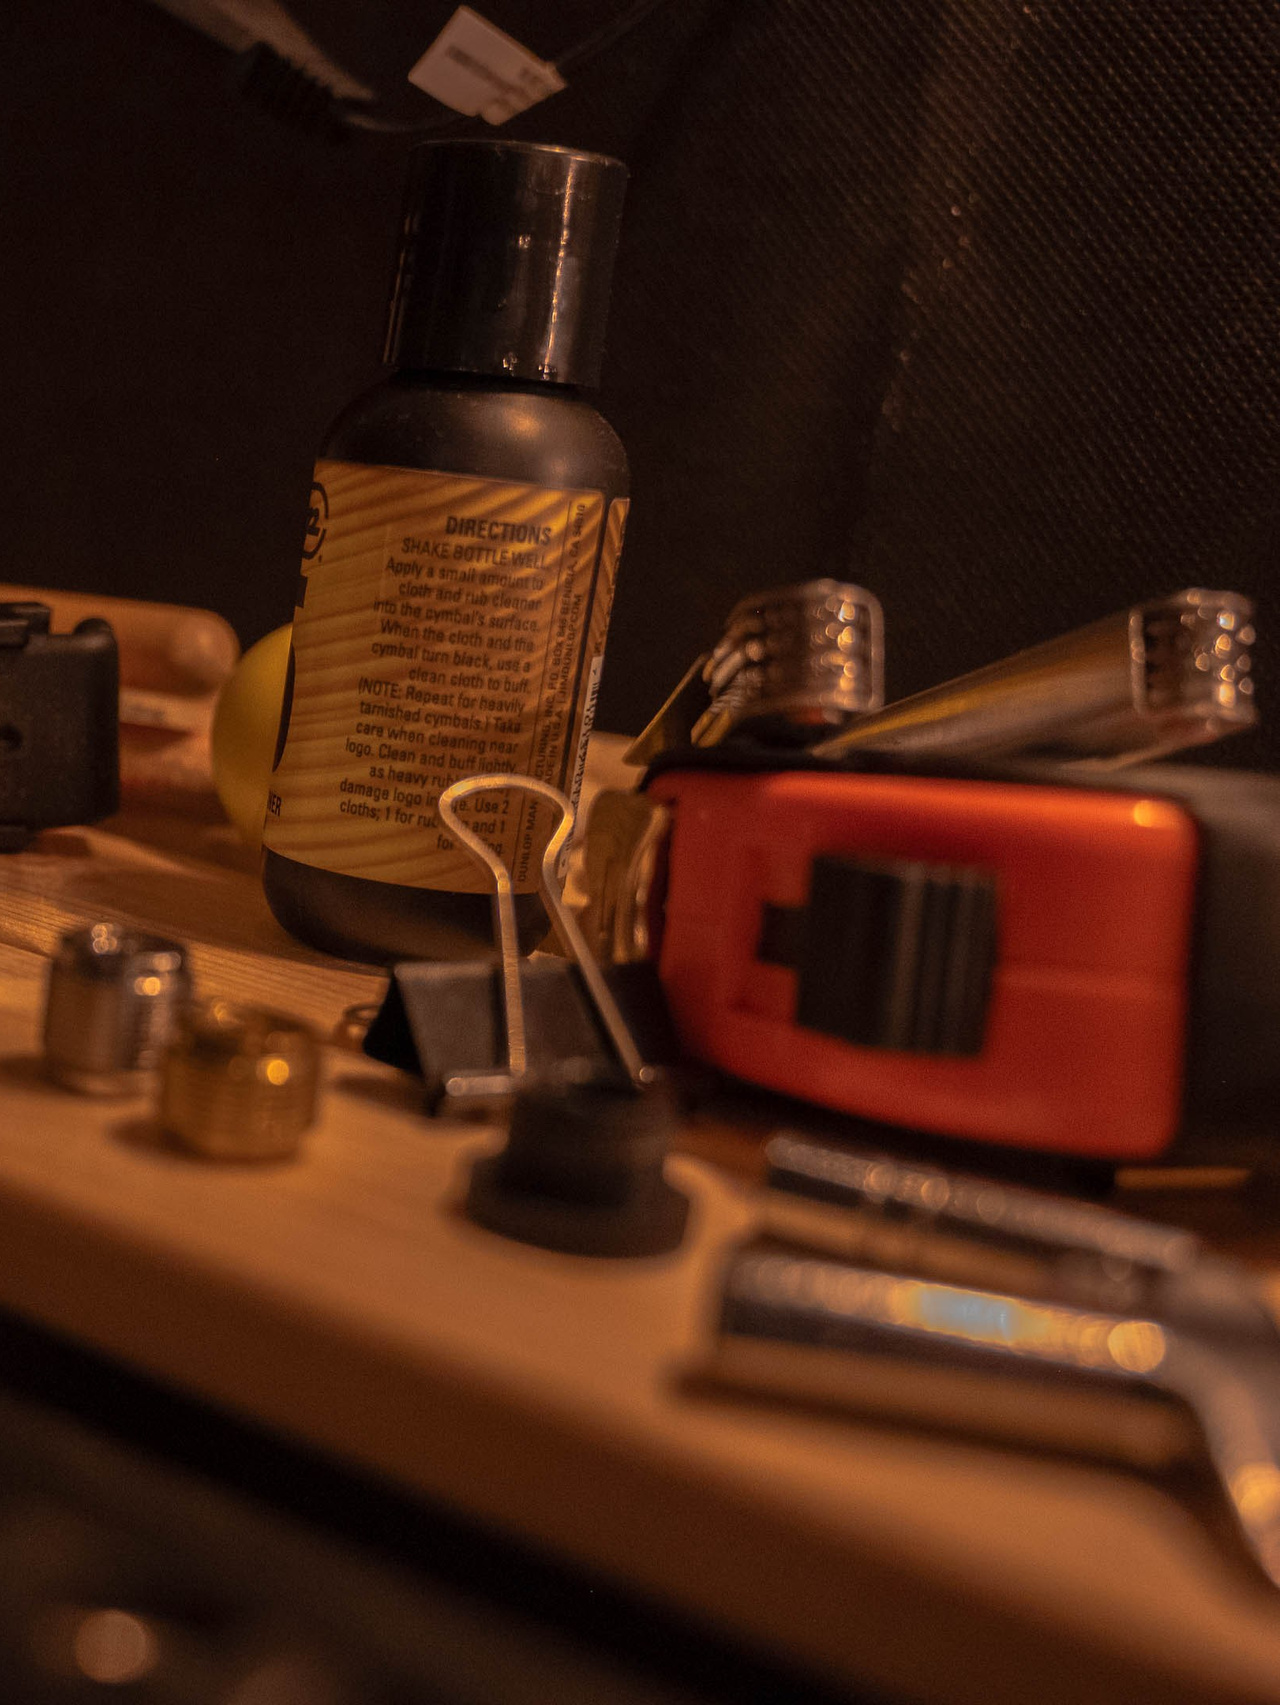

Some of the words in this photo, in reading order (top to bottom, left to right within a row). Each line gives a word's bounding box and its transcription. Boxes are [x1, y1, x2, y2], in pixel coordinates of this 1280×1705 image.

[446, 516, 552, 546] DIRECTIONS
[402, 537, 451, 559] SHAKE
[452, 545, 506, 567] BOTTLE
[511, 552, 547, 570] WELL
[386, 556, 422, 578] Apply
[426, 566, 434, 578] a
[438, 567, 475, 583] small
[478, 573, 530, 590] amount
[532, 577, 544, 591] to
[399, 581, 430, 598] cloth
[436, 586, 461, 602] and
[466, 591, 488, 606] rub
[492, 594, 542, 611] cleaner
[373, 598, 396, 614] into
[400, 602, 420, 619] the
[425, 605, 485, 627] cymbal's
[488, 613, 540, 632] surface.
[380, 618, 420, 639] When
[422, 624, 444, 643] the
[448, 628, 482, 646] cloth
[486, 632, 512, 650] and
[514, 636, 534, 652] the
[371, 640, 418, 660] cymbal
[422, 646, 450, 663] turn
[453, 648, 494, 670] black,
[497, 658, 520, 672] use
[522, 660, 530, 673] a
[358, 676, 402, 700] (NOTE:
[406, 686, 454, 708] Repeat
[458, 692, 477, 708] for
[480, 694, 525, 715] heavily
[408, 668, 446, 684] clean
[450, 672, 484, 688] cloth
[488, 676, 500, 691] to
[504, 677, 531, 694] buff.
[360, 700, 420, 723] tarnished
[493, 716, 521, 733] Take
[356, 721, 384, 738] care
[388, 724, 424, 744] when
[428, 731, 486, 755] cleaning
[489, 741, 520, 756] near
[346, 738, 372, 757] logo.
[378, 743, 416, 762] Clean
[420, 748, 445, 766] and
[449, 754, 478, 770] buff
[479, 757, 516, 774] lightly
[519, 833, 533, 882] DUNLOP
[552, 641, 563, 666] BOX
[369, 764, 384, 778] as
[388, 765, 428, 786] heavy
[545, 762, 556, 784] ADE
[340, 778, 388, 801] damage
[393, 786, 421, 806] logo
[475, 798, 499, 812] Use
[502, 800, 509, 814] 2
[340, 800, 379, 822] cloths;
[385, 805, 390, 820] 1
[396, 810, 412, 824] for
[472, 820, 494, 834] and
[500, 821, 505, 832] 1
